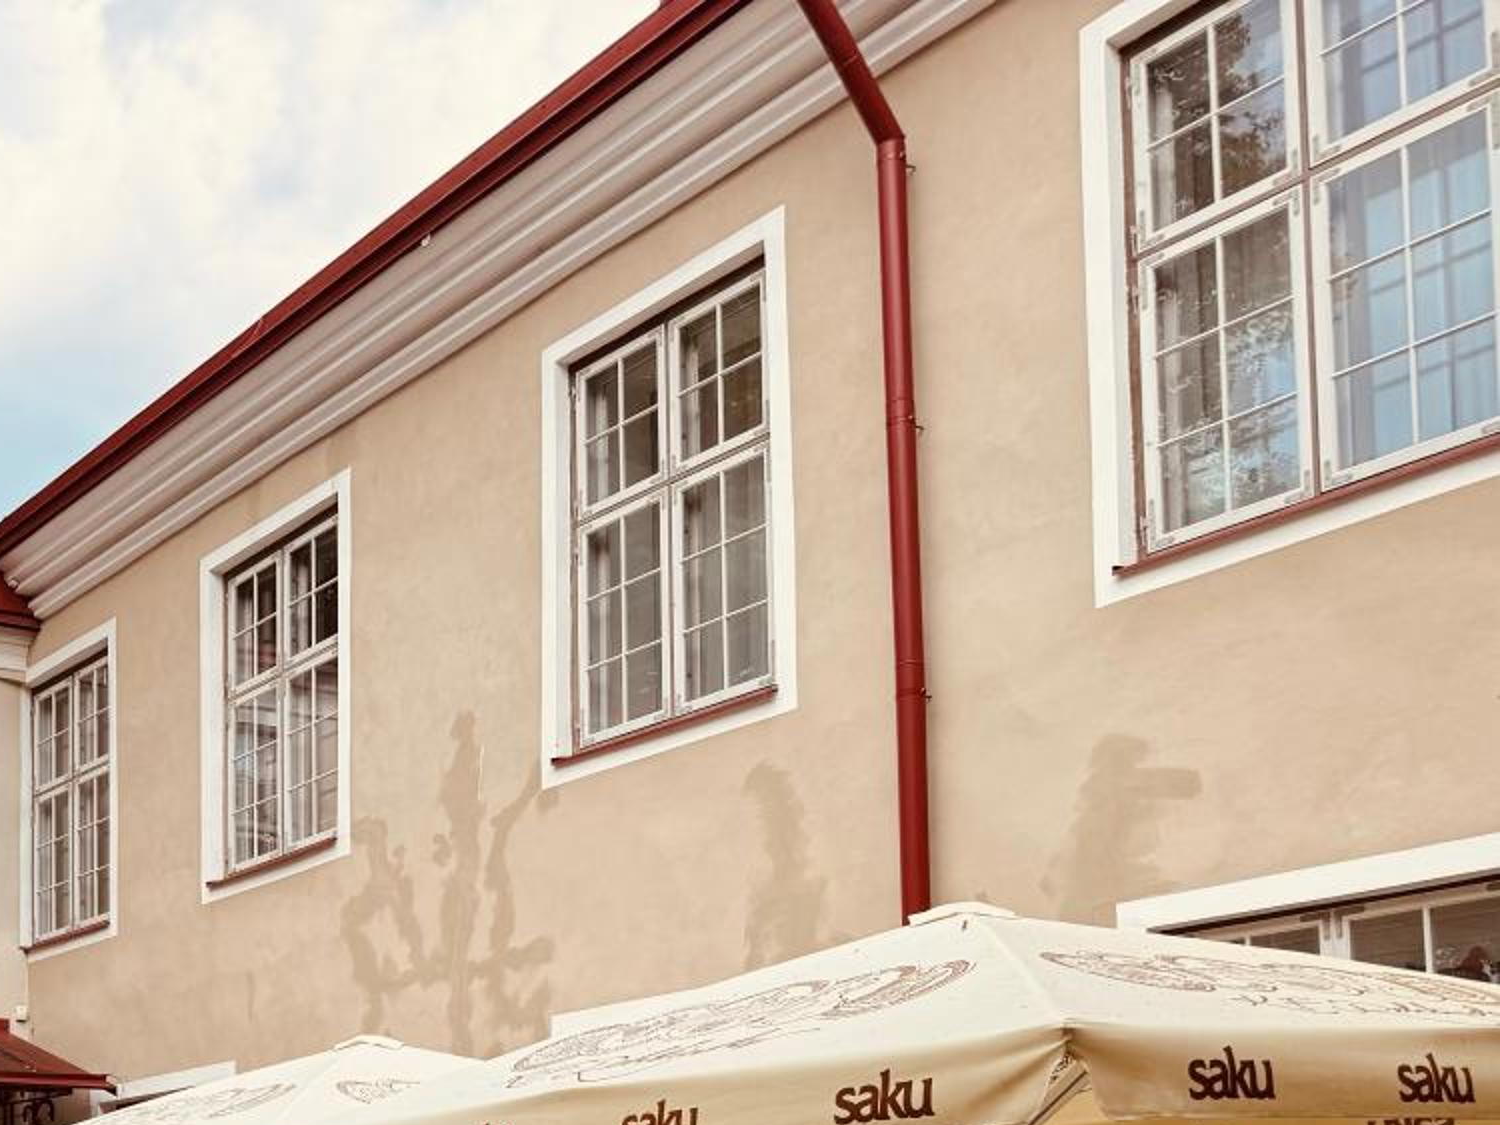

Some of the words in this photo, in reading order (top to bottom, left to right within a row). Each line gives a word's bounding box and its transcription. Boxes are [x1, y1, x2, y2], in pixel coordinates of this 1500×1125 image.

[834, 1069, 935, 1125] saku
[1188, 1046, 1277, 1100] saku
[1398, 1053, 1476, 1103] saku
